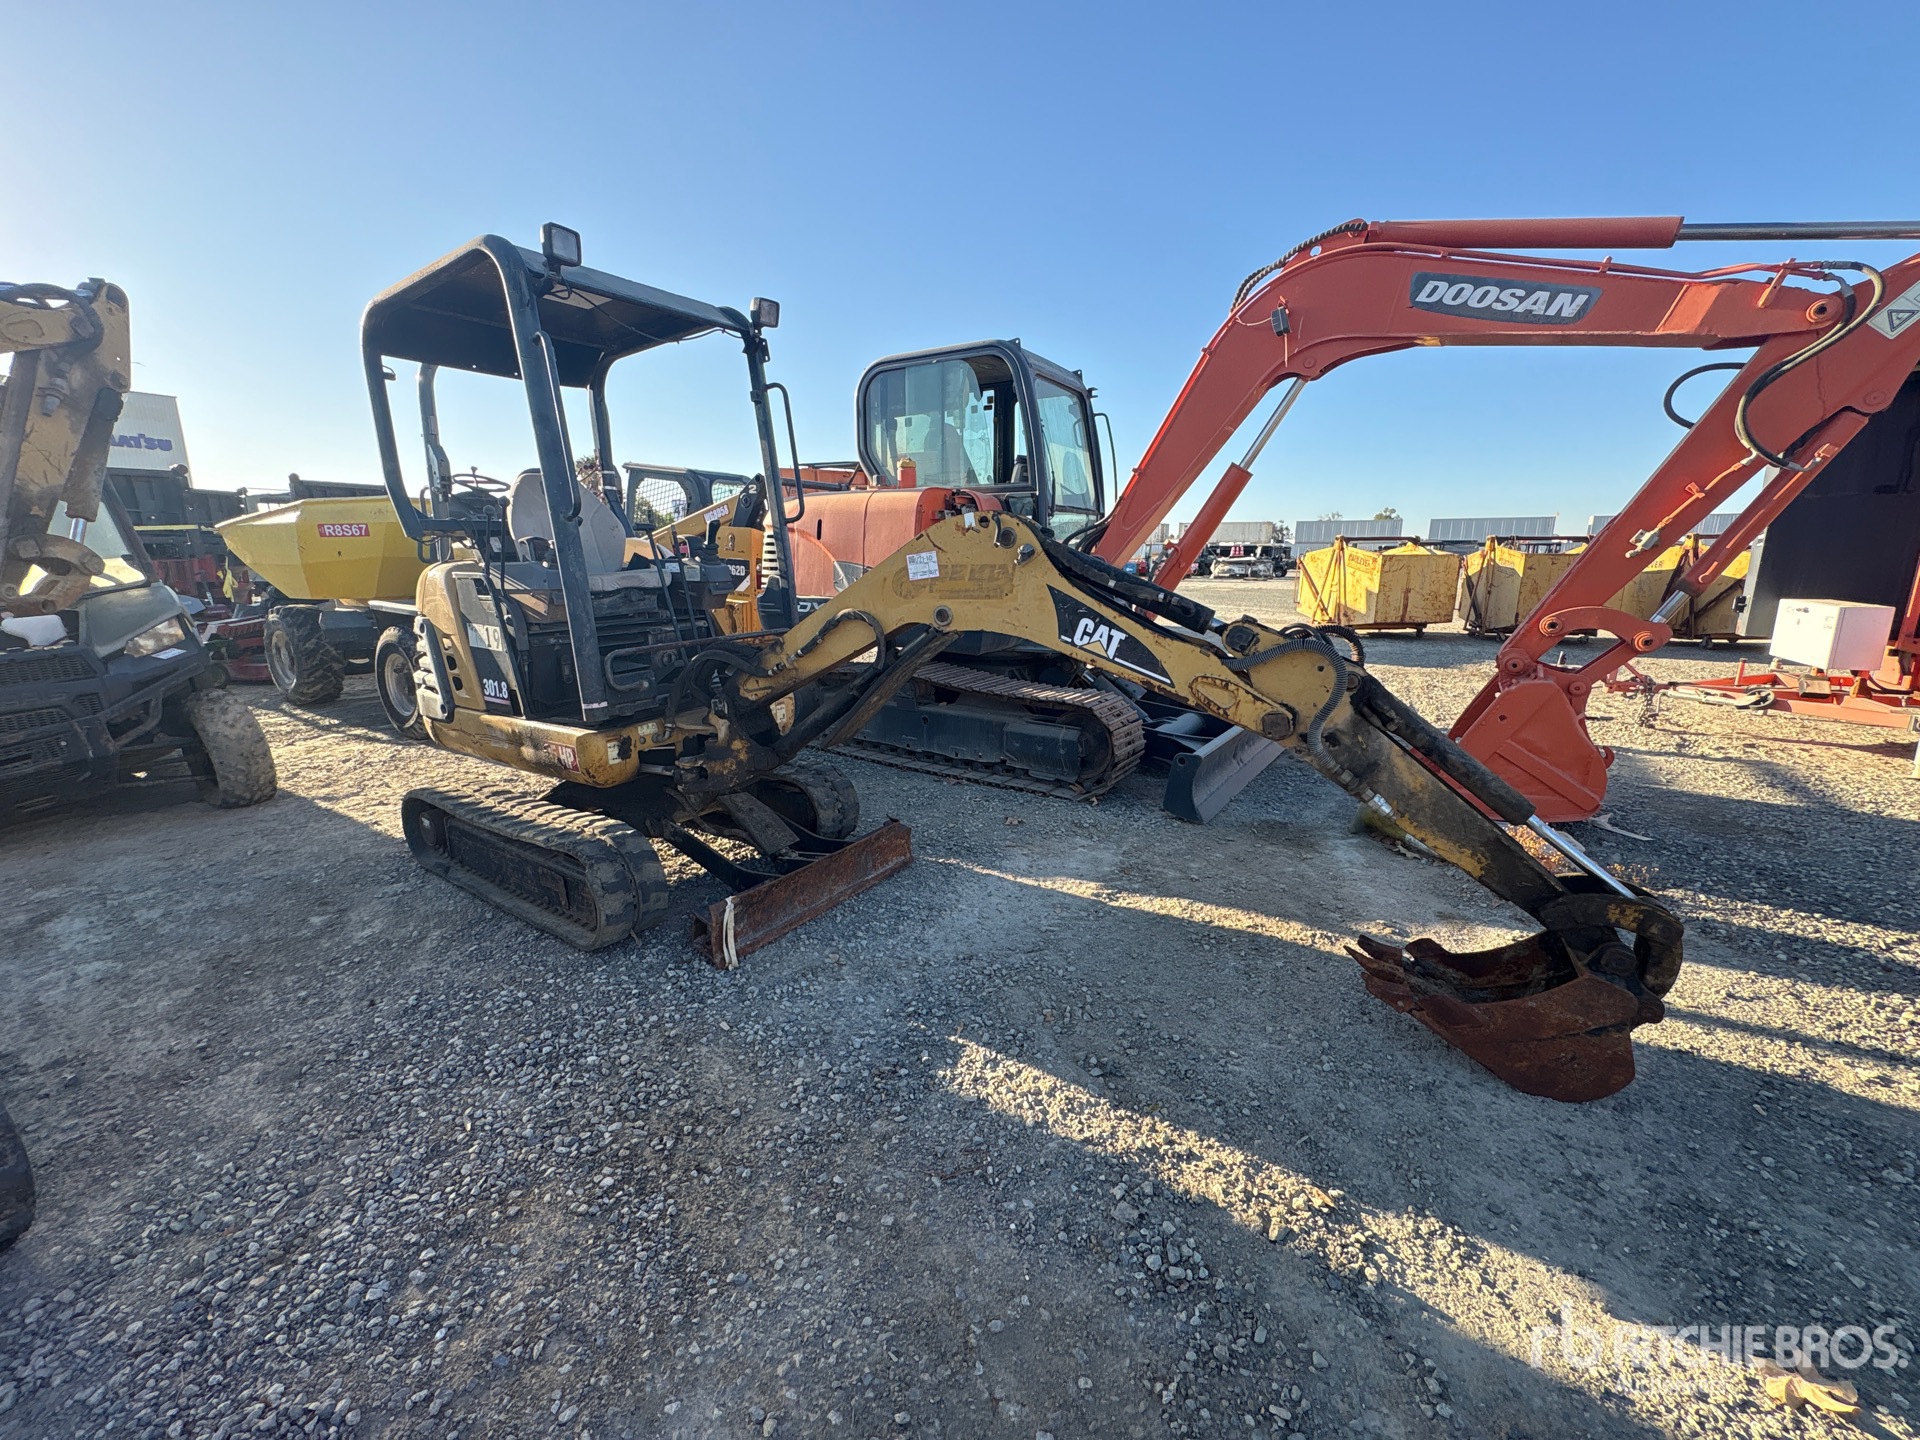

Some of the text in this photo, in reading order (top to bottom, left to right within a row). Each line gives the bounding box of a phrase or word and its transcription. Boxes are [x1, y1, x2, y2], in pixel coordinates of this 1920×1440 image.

[1415, 280, 1589, 318] DOOSAN
[111, 433, 172, 452] ATSU
[323, 524, 367, 537] R8S67
[1073, 617, 1127, 660] CAT
[482, 678, 509, 699] 301.8
